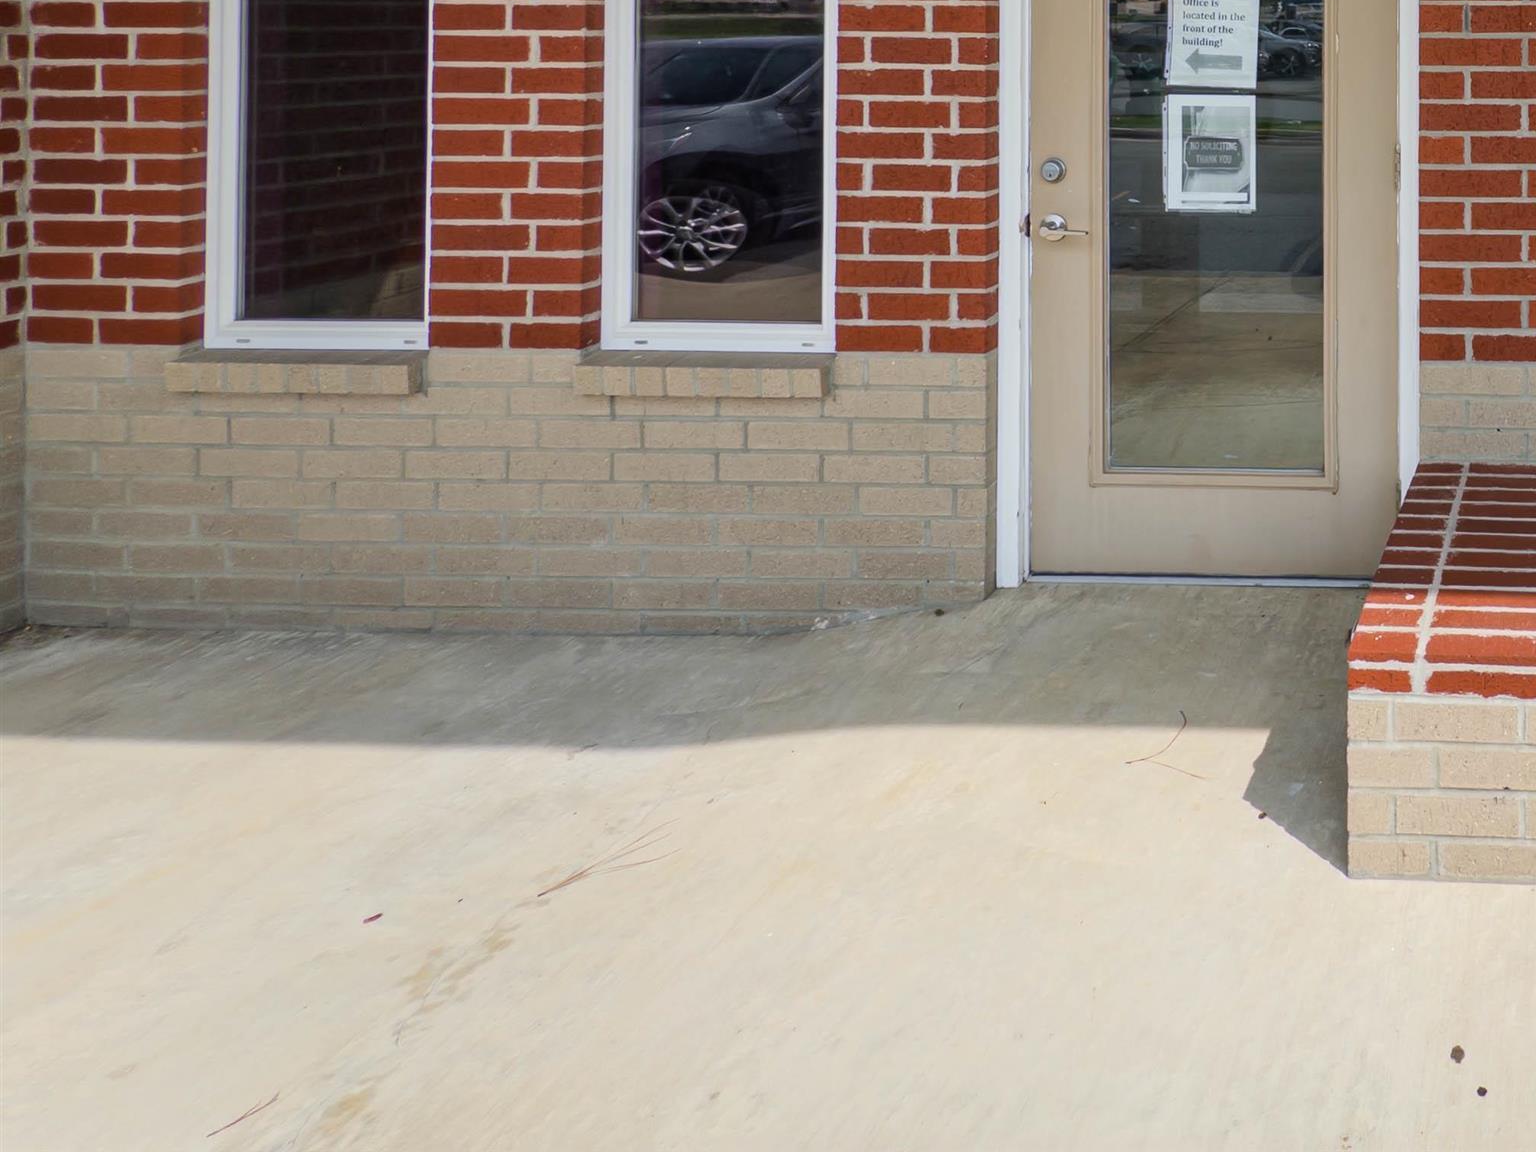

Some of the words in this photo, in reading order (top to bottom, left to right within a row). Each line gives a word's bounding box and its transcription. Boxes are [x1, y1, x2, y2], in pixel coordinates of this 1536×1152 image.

[1211, 0, 1219, 7] is
[1182, 11, 1215, 20] located
[1218, 12, 1227, 21] in
[1230, 13, 1246, 21] the
[1182, 24, 1205, 33] front
[1207, 25, 1217, 33] of
[1218, 26, 1234, 34] the
[1182, 36, 1223, 48] building!
[1190, 142, 1200, 150] NO
[1200, 142, 1238, 151] SOLICITING
[1218, 154, 1232, 164] YOU
